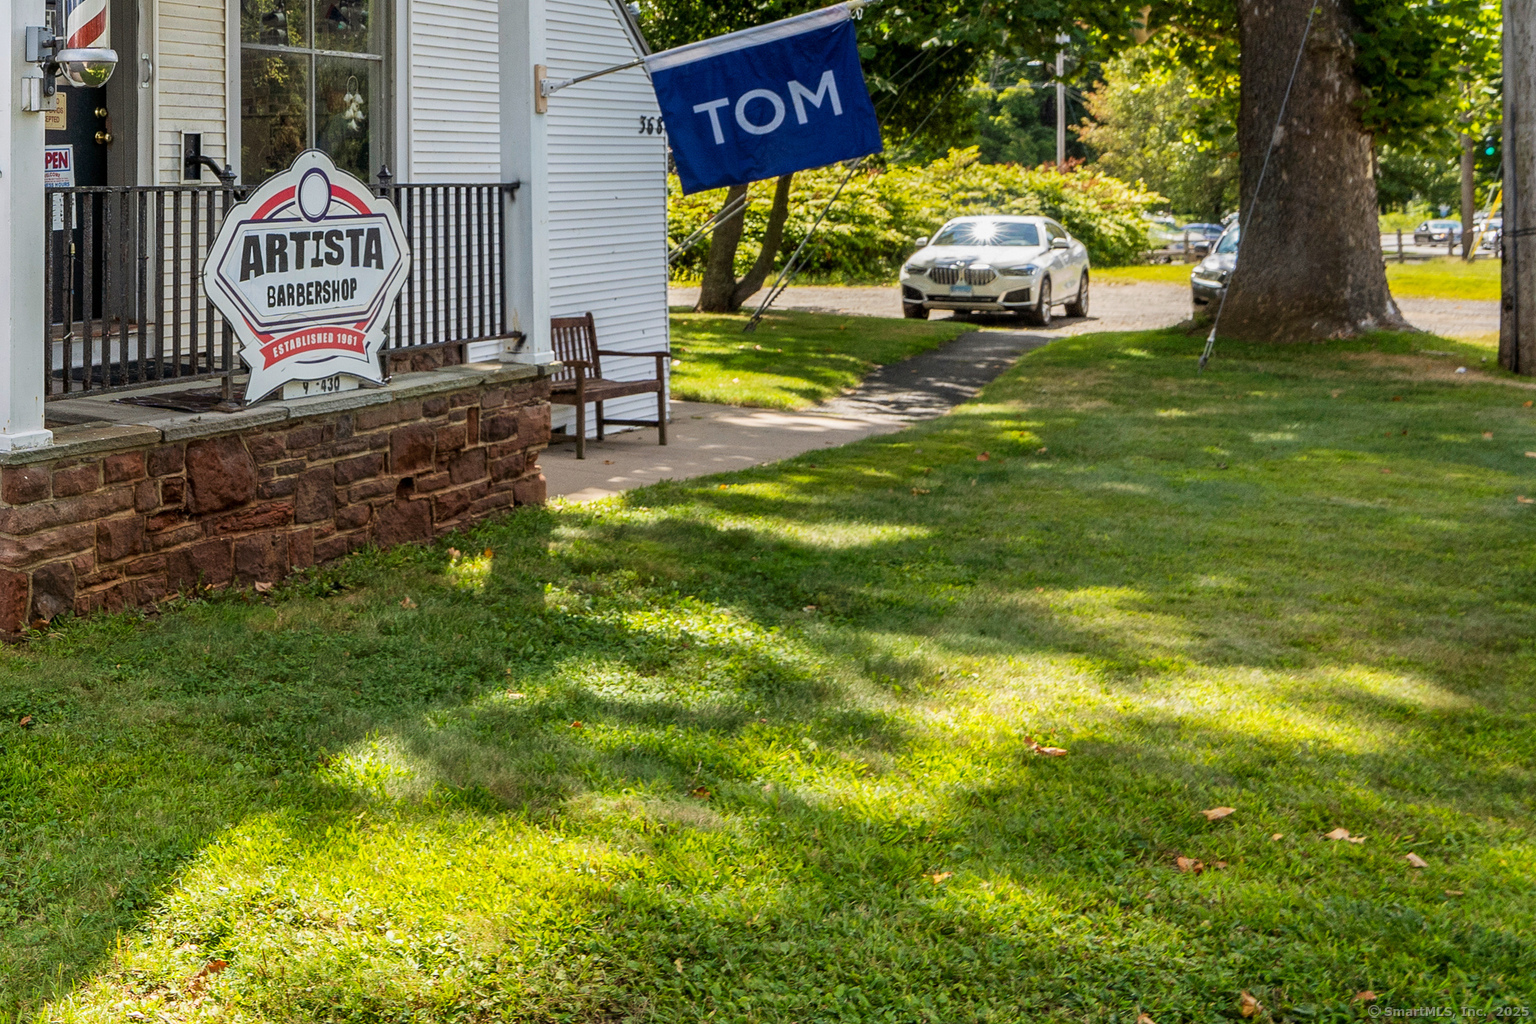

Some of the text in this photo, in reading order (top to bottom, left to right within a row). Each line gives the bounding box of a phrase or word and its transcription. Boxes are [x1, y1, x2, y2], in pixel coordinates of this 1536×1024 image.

[693, 70, 843, 145] TOM
[638, 115, 663, 135] 368
[45, 151, 68, 169] PEN
[240, 227, 384, 282] ARTISTA
[267, 278, 357, 308] BARBERSHOP
[273, 332, 358, 357] ESTABLISHED 1961
